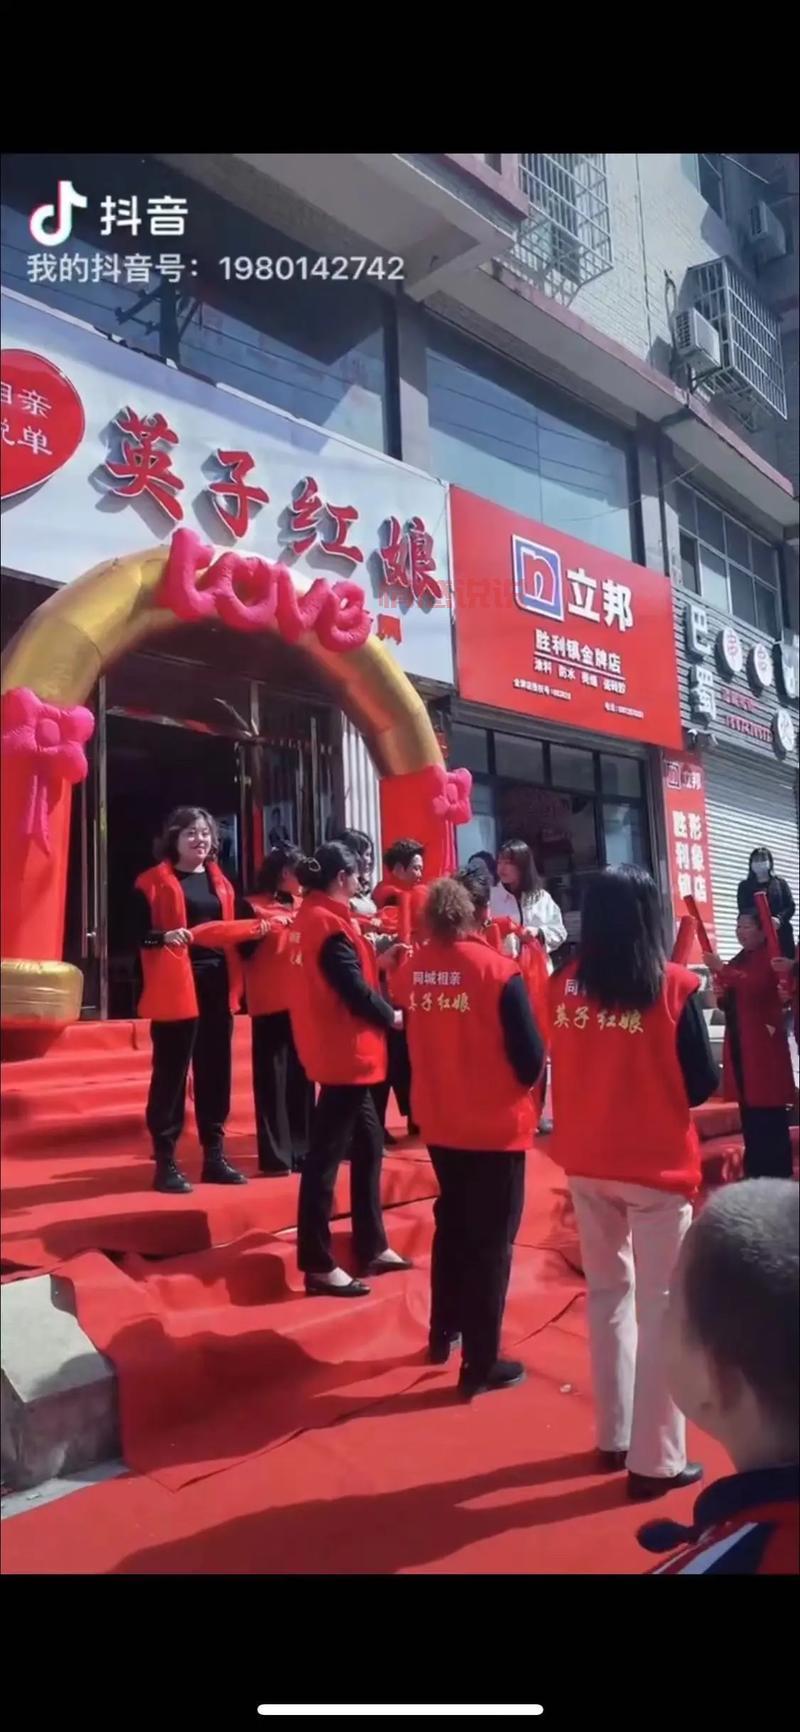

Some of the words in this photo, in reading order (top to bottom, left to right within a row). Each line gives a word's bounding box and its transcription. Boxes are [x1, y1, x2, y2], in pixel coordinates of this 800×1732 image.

[107, 406, 441, 602] 英子红娘
[567, 567, 633, 632] 立邦
[535, 629, 621, 673] 胜利镇金牌店
[412, 970, 462, 986] 同城相亲
[553, 1002, 644, 1034] 英子红娘
